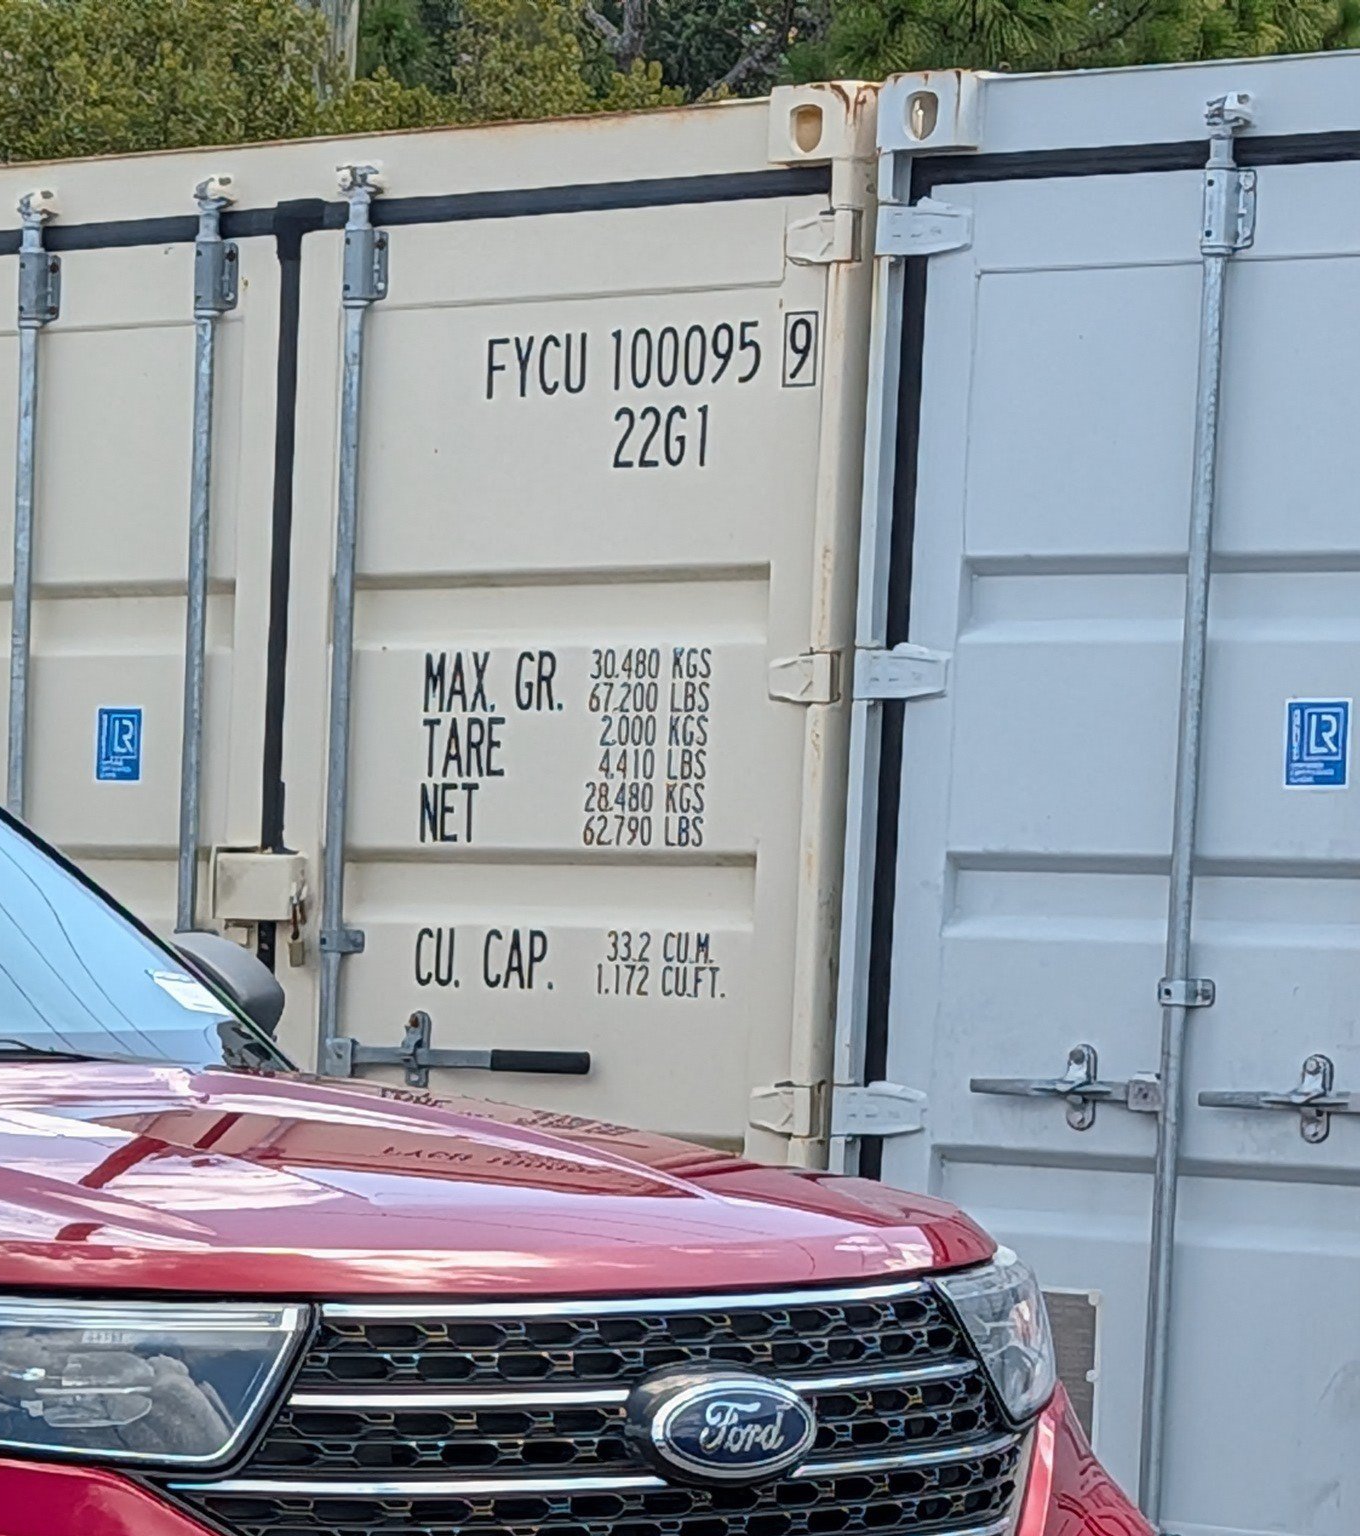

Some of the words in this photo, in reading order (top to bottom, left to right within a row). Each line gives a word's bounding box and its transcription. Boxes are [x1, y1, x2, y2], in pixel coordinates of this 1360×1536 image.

[486, 332, 588, 400] FYCU
[611, 320, 761, 391] 100095
[788, 317, 813, 380] 9
[612, 404, 709, 468] 22G1
[423, 651, 495, 713] MAX.
[515, 650, 563, 711] GR.
[590, 647, 660, 680] 30.480
[672, 647, 712, 679] KGS
[670, 681, 710, 713] LBS
[422, 717, 506, 778] TARE
[668, 714, 709, 746] KGS
[667, 748, 707, 780] LBS
[419, 782, 480, 843] NET
[665, 782, 705, 813] KGS
[664, 815, 704, 847] LBS
[415, 928, 460, 989] CU.
[483, 929, 554, 991] CAP.
[597, 963, 649, 996] 1.172
[699, 1400, 795, 1456] Ford
